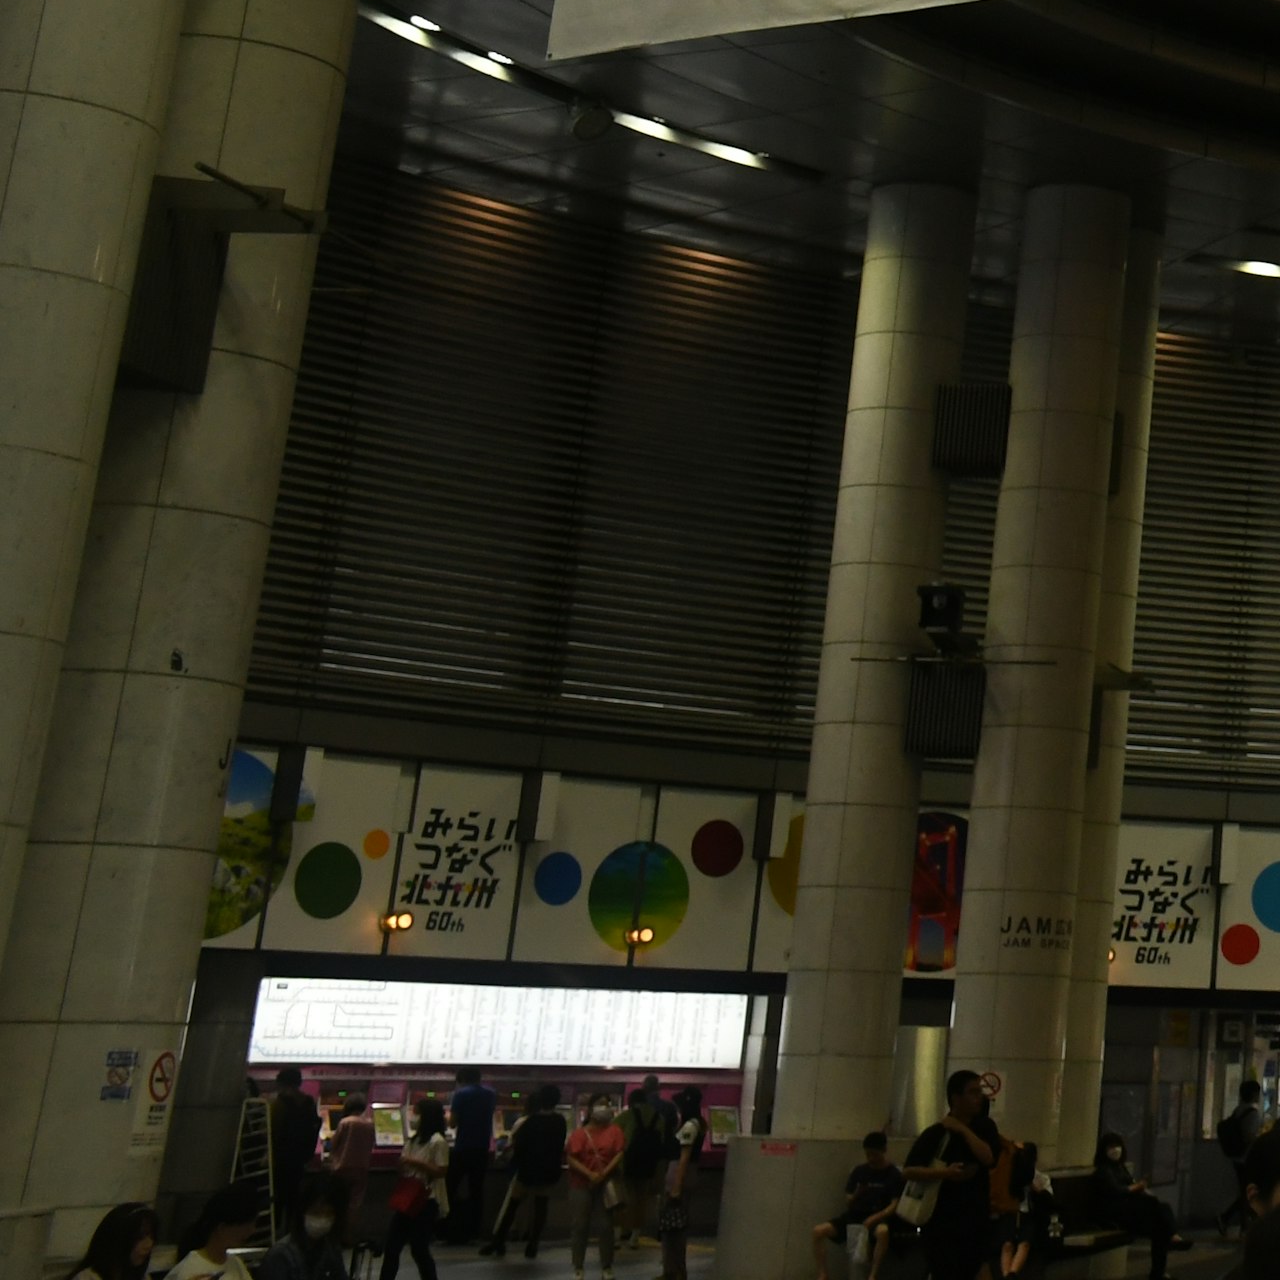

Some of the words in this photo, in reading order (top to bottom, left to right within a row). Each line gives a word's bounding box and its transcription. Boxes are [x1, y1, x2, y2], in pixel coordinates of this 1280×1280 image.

[421, 808, 517, 841] みらい
[414, 843, 512, 876] つなぐ
[1125, 858, 1212, 886] みらい
[400, 874, 500, 909] 北九州
[1119, 887, 1209, 915] つなぐ
[425, 911, 465, 932] 60th
[1111, 915, 1199, 943] 北九州
[1134, 947, 1170, 964] 60th
